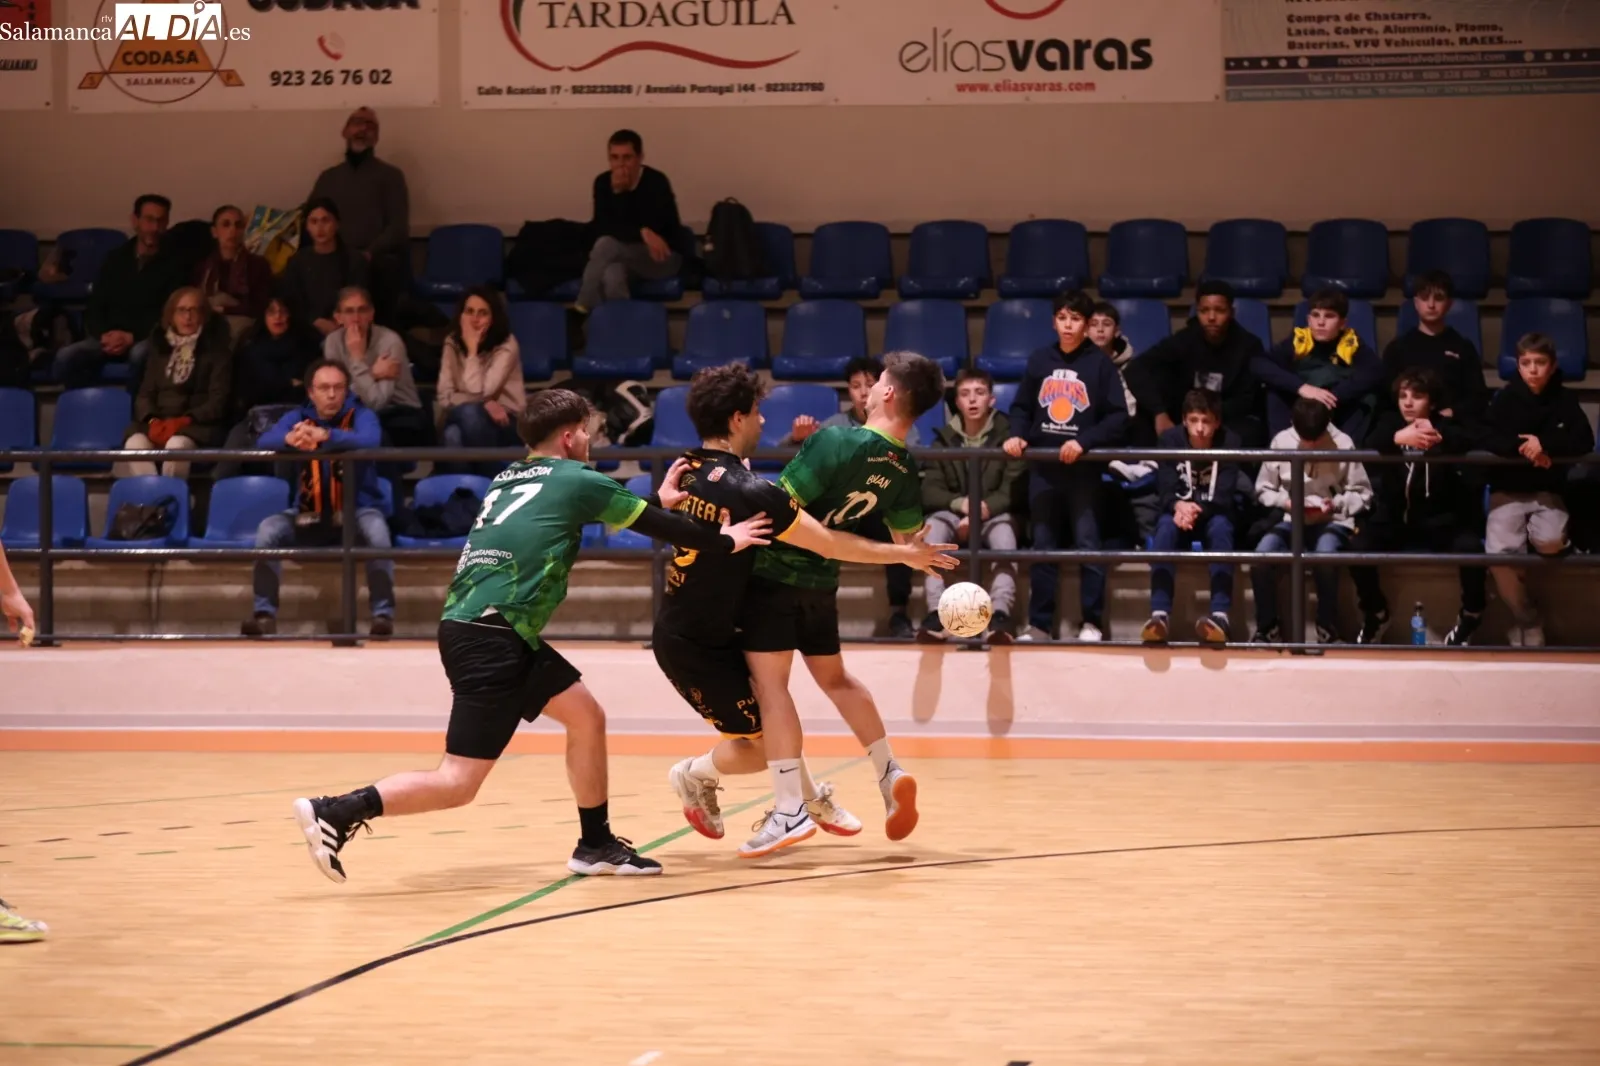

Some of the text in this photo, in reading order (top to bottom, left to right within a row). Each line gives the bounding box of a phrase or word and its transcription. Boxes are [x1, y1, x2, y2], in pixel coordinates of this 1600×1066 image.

[1286, 13, 1341, 24] Compra
[1345, 12, 1361, 22] de
[121, 51, 200, 66] CODASA
[126, 76, 196, 87] SALAMANCA
[269, 69, 393, 87] 923 26 76 02
[477, 85, 503, 96] Calle
[506, 84, 547, 96] Acacias
[645, 83, 686, 94] Avenida
[690, 83, 734, 96] Portugal
[955, 79, 1096, 93] www.eliasvaras.com
[475, 483, 544, 529] 17
